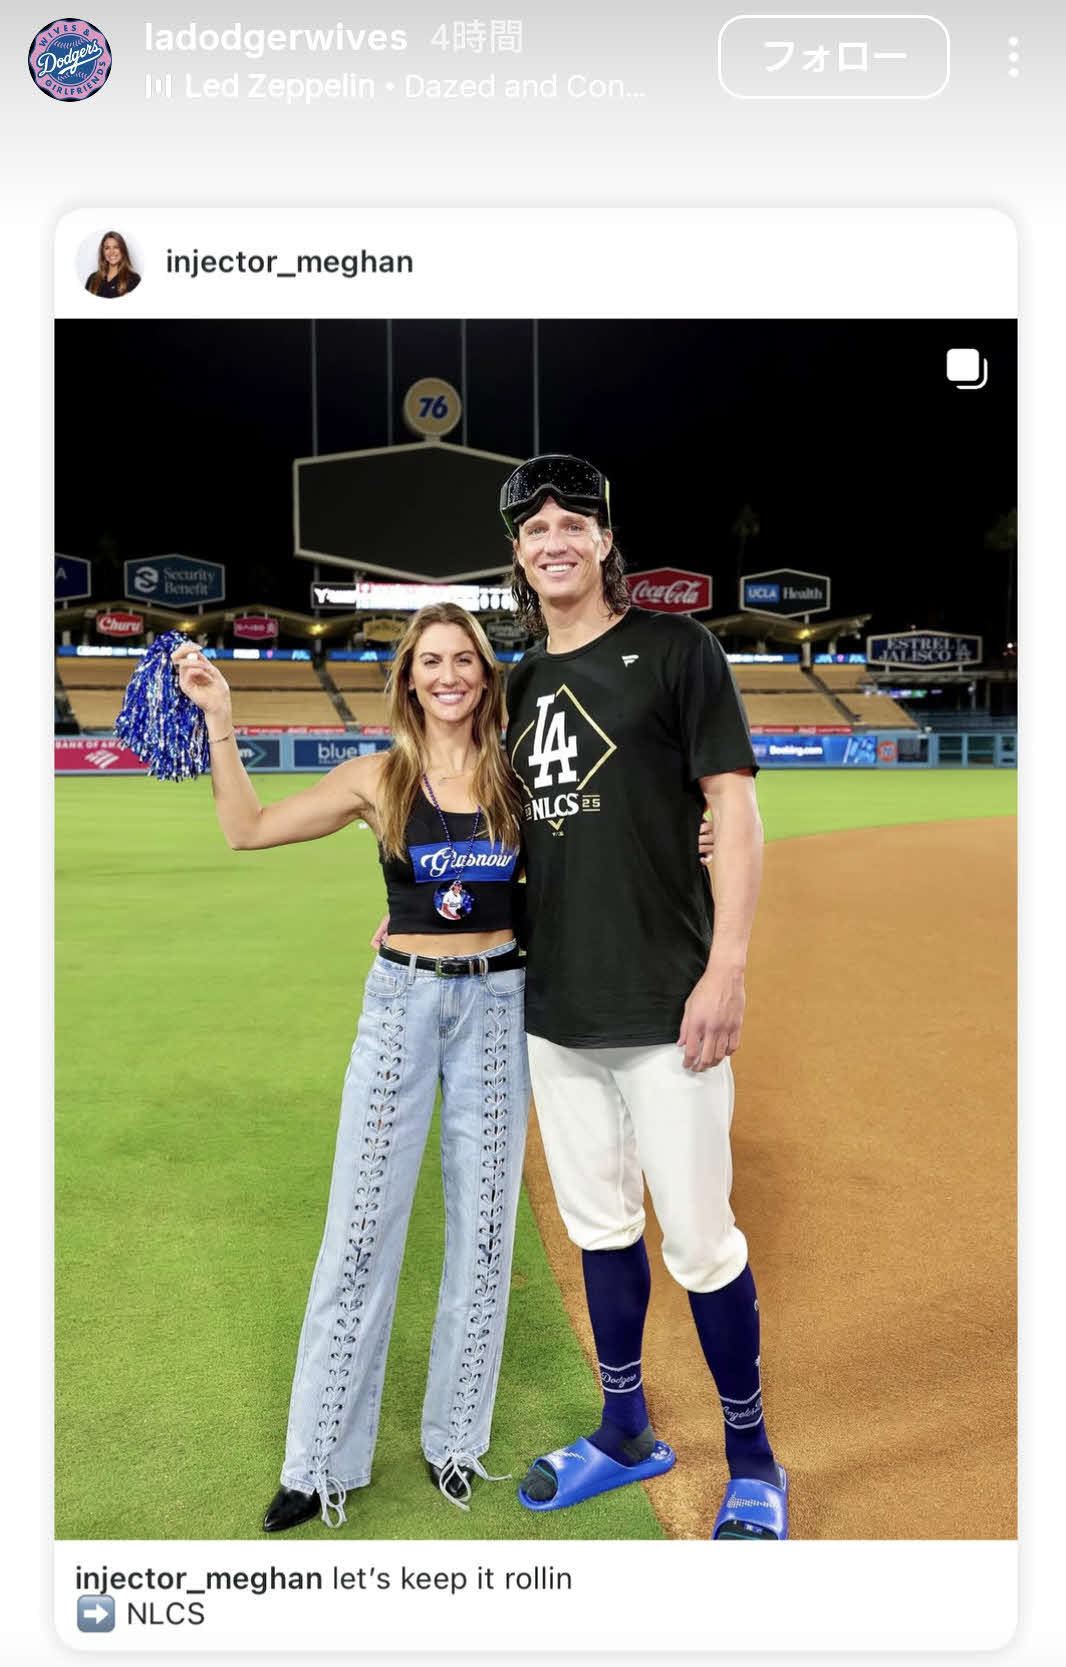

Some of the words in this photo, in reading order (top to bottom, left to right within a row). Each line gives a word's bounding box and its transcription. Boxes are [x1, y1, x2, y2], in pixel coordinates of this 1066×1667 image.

[39, 25, 77, 47] WIVES
[37, 40, 103, 77] Dodgers
[45, 61, 106, 95] GIRLFRIENDS
[417, 395, 448, 420] 76
[163, 568, 215, 584] Security
[164, 581, 209, 596] Benefit
[748, 587, 777, 599] UCLA
[783, 586, 823, 600] Health
[879, 650, 951, 662] JALISCO
[317, 742, 358, 759] blue
[528, 694, 578, 789] LA
[531, 792, 580, 821] NLCS
[582, 798, 600, 808] 25
